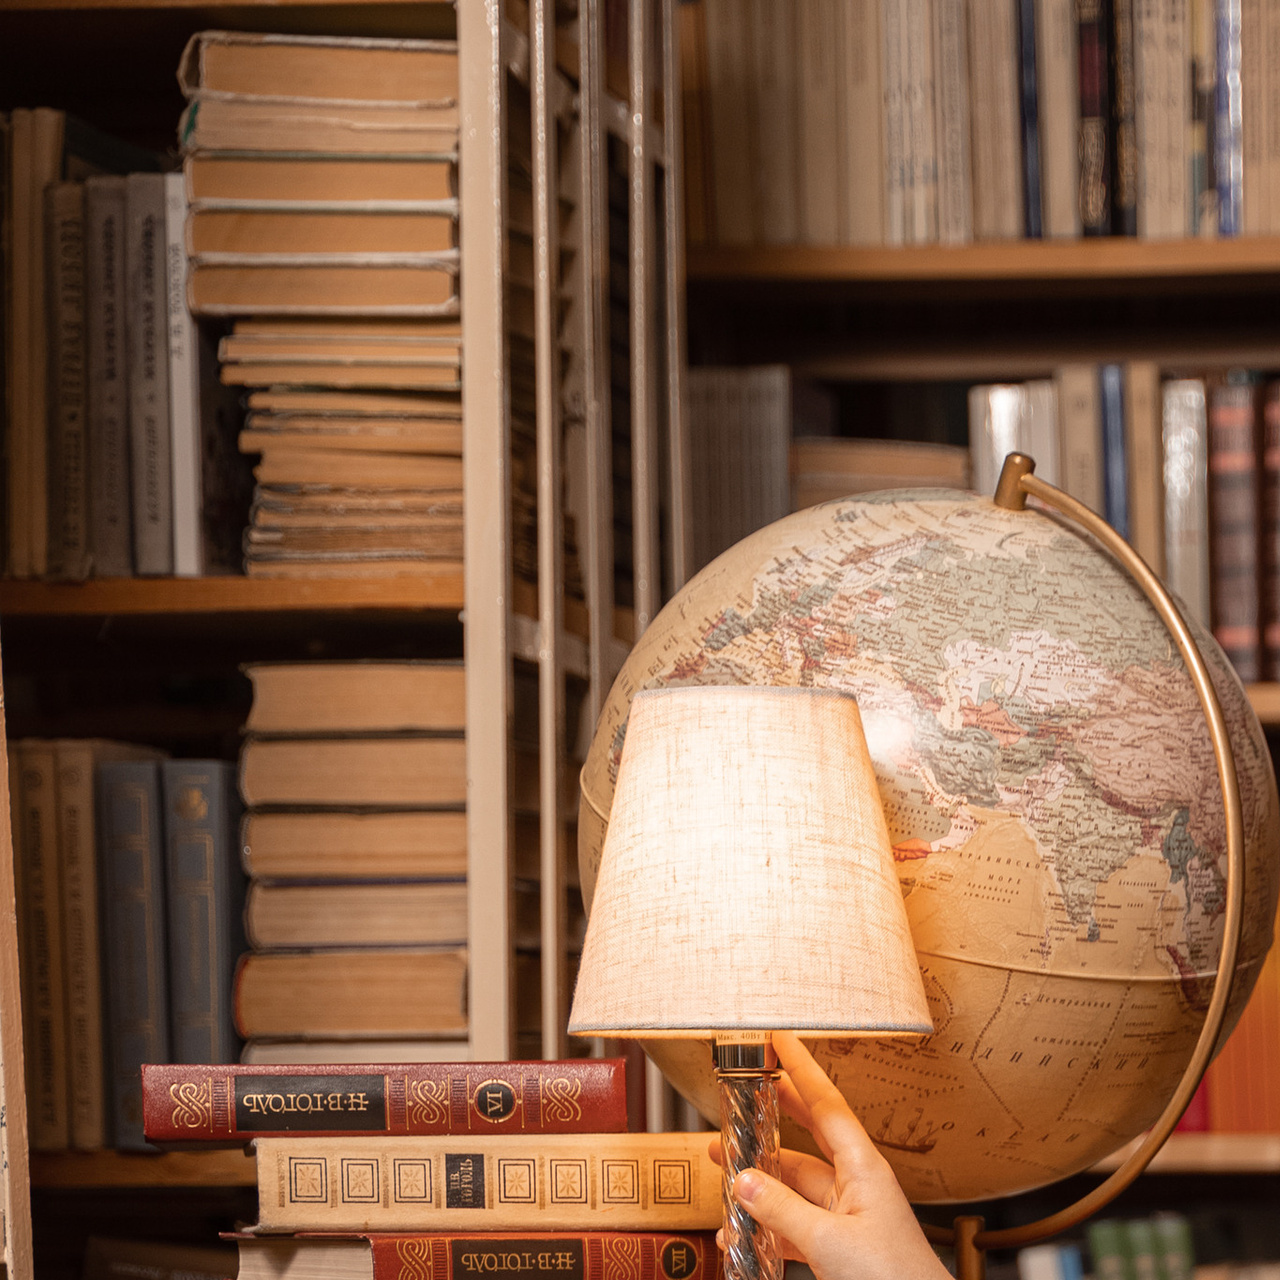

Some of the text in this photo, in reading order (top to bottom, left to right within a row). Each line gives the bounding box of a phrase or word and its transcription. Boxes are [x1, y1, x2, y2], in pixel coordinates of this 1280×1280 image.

[953, 823, 974, 832] ОМАН
[959, 851, 1050, 872] АРАВИЙСКОЕ
[988, 874, 1021, 885] МОРЕ
[1037, 993, 1112, 1009] Центральная
[941, 1120, 1081, 1144] ОКЕАН
